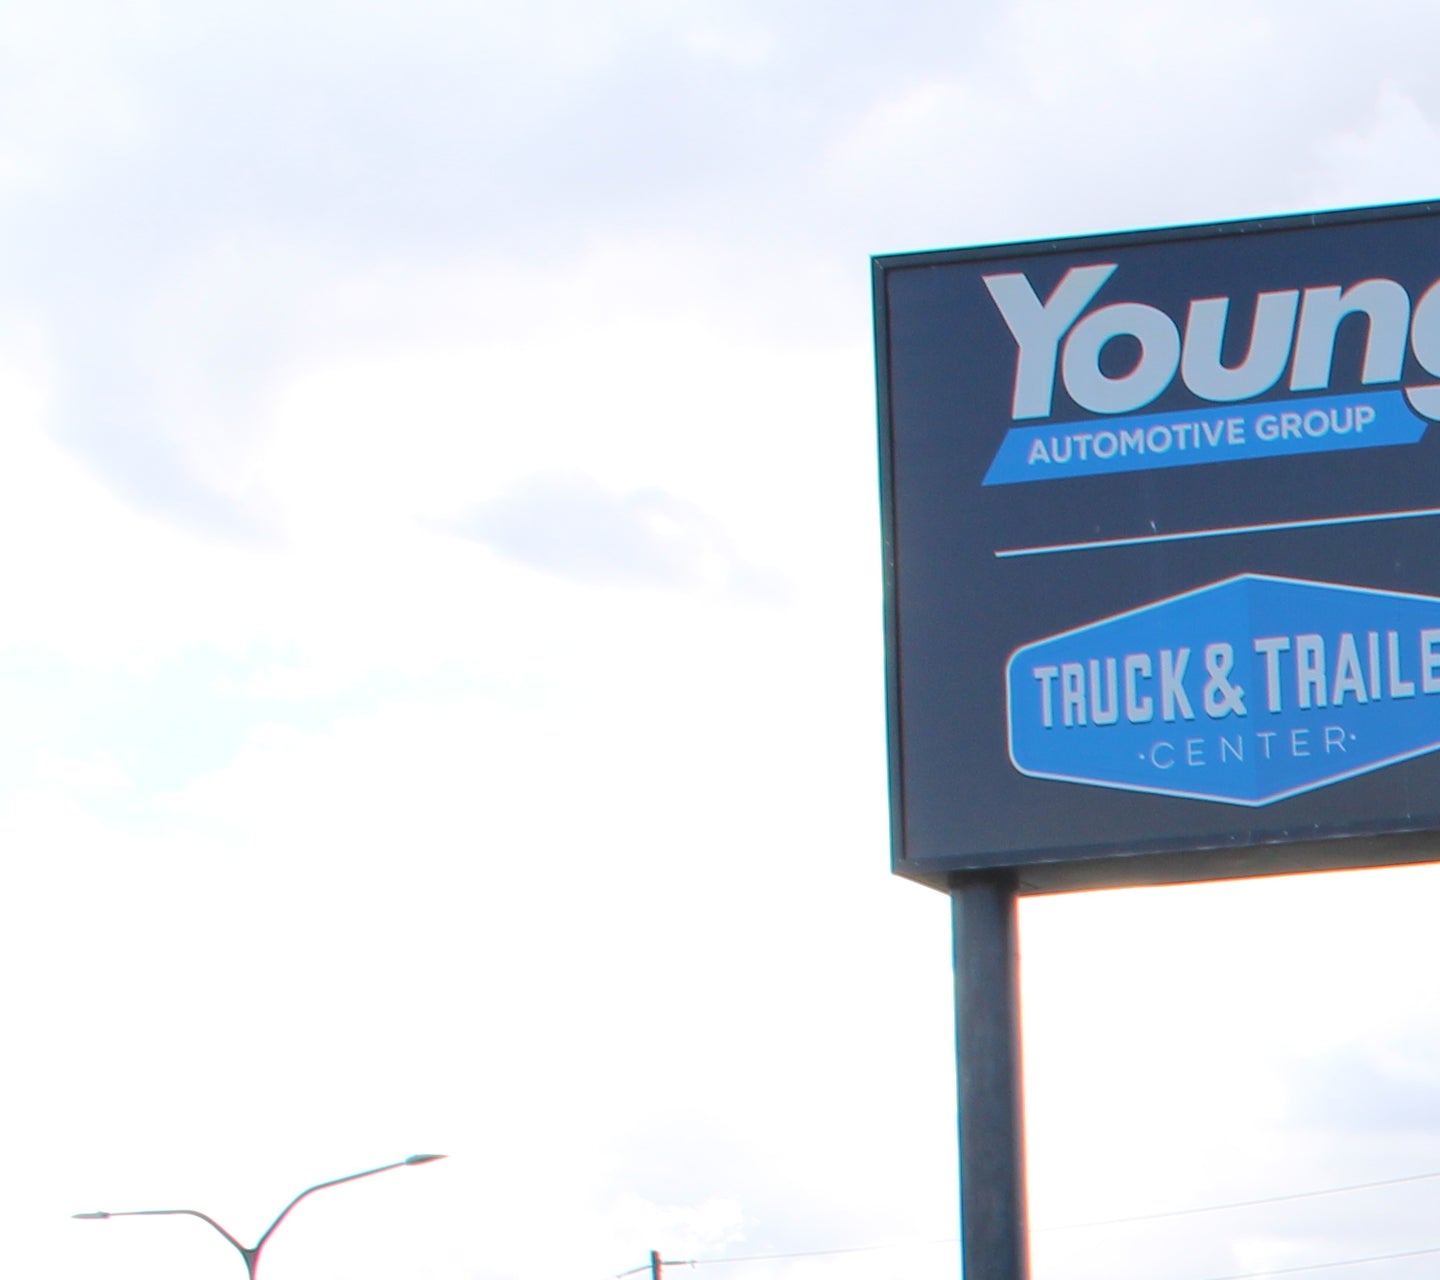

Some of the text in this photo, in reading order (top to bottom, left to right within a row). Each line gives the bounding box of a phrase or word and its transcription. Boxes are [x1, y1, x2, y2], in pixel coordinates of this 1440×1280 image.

[1028, 405, 1376, 465] AUTOMOTIVE GROUP
[1033, 647, 1195, 727] TRUCK
[1150, 726, 1347, 769] CENTER
